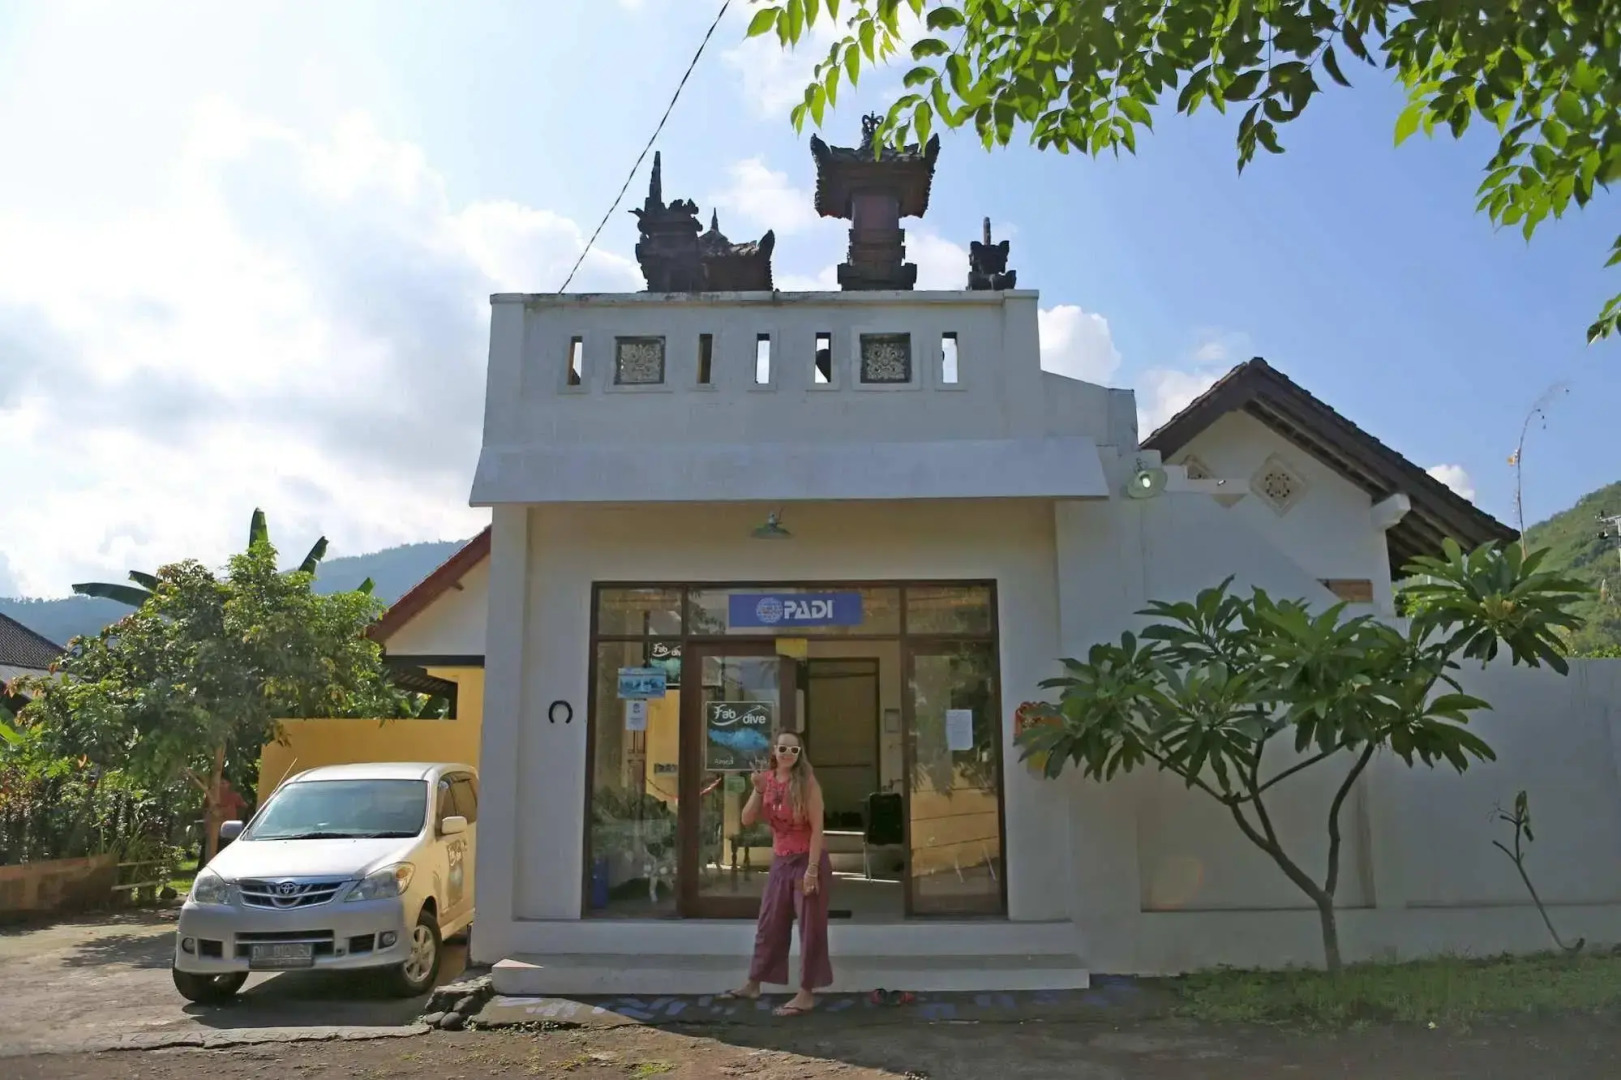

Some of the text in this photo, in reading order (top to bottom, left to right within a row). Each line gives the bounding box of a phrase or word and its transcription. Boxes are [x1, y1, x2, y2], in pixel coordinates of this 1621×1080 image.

[784, 600, 833, 620] PADI
[653, 642, 668, 653] Fab
[713, 704, 767, 724] Fab dive
